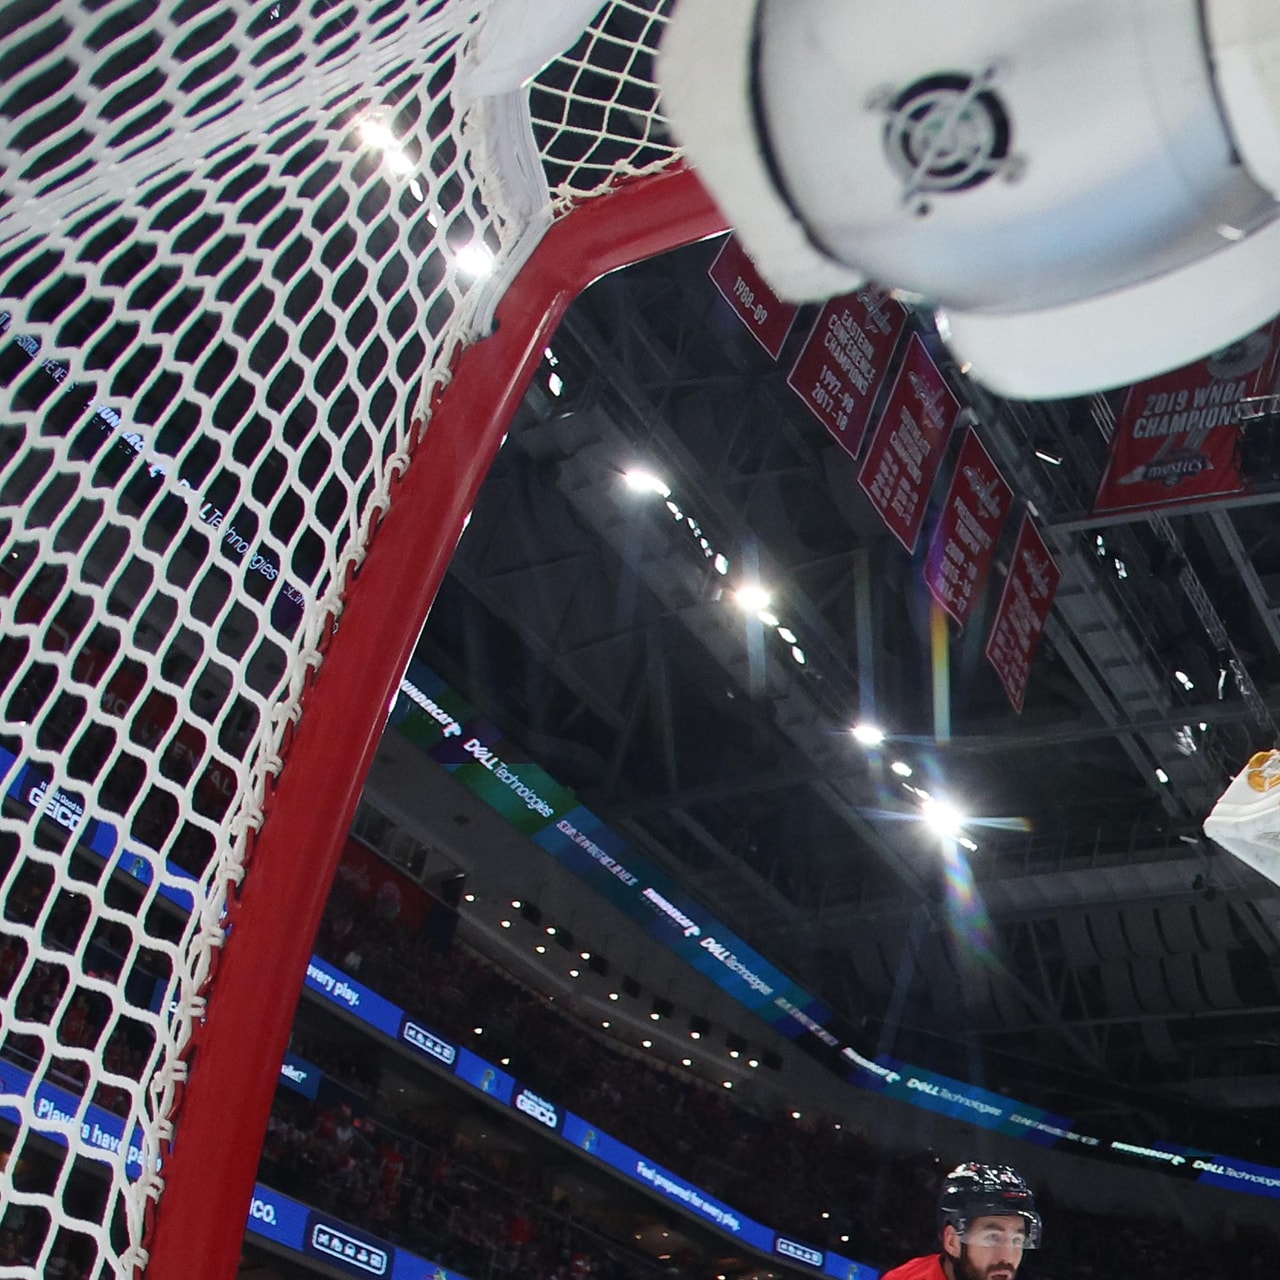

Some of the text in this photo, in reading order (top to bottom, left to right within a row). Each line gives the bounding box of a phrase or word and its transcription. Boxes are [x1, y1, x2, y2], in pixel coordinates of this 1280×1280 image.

[828, 313, 876, 383] CONFERENCE
[841, 309, 875, 361] EASTERN
[824, 331, 870, 396] CHAMPIONS
[1133, 404, 1240, 439] CHAMPIONS
[1143, 381, 1247, 416] 2019 WNBA
[464, 737, 499, 771] DELL
[493, 762, 555, 819] Technologies
[516, 1092, 558, 1129] GEICO
